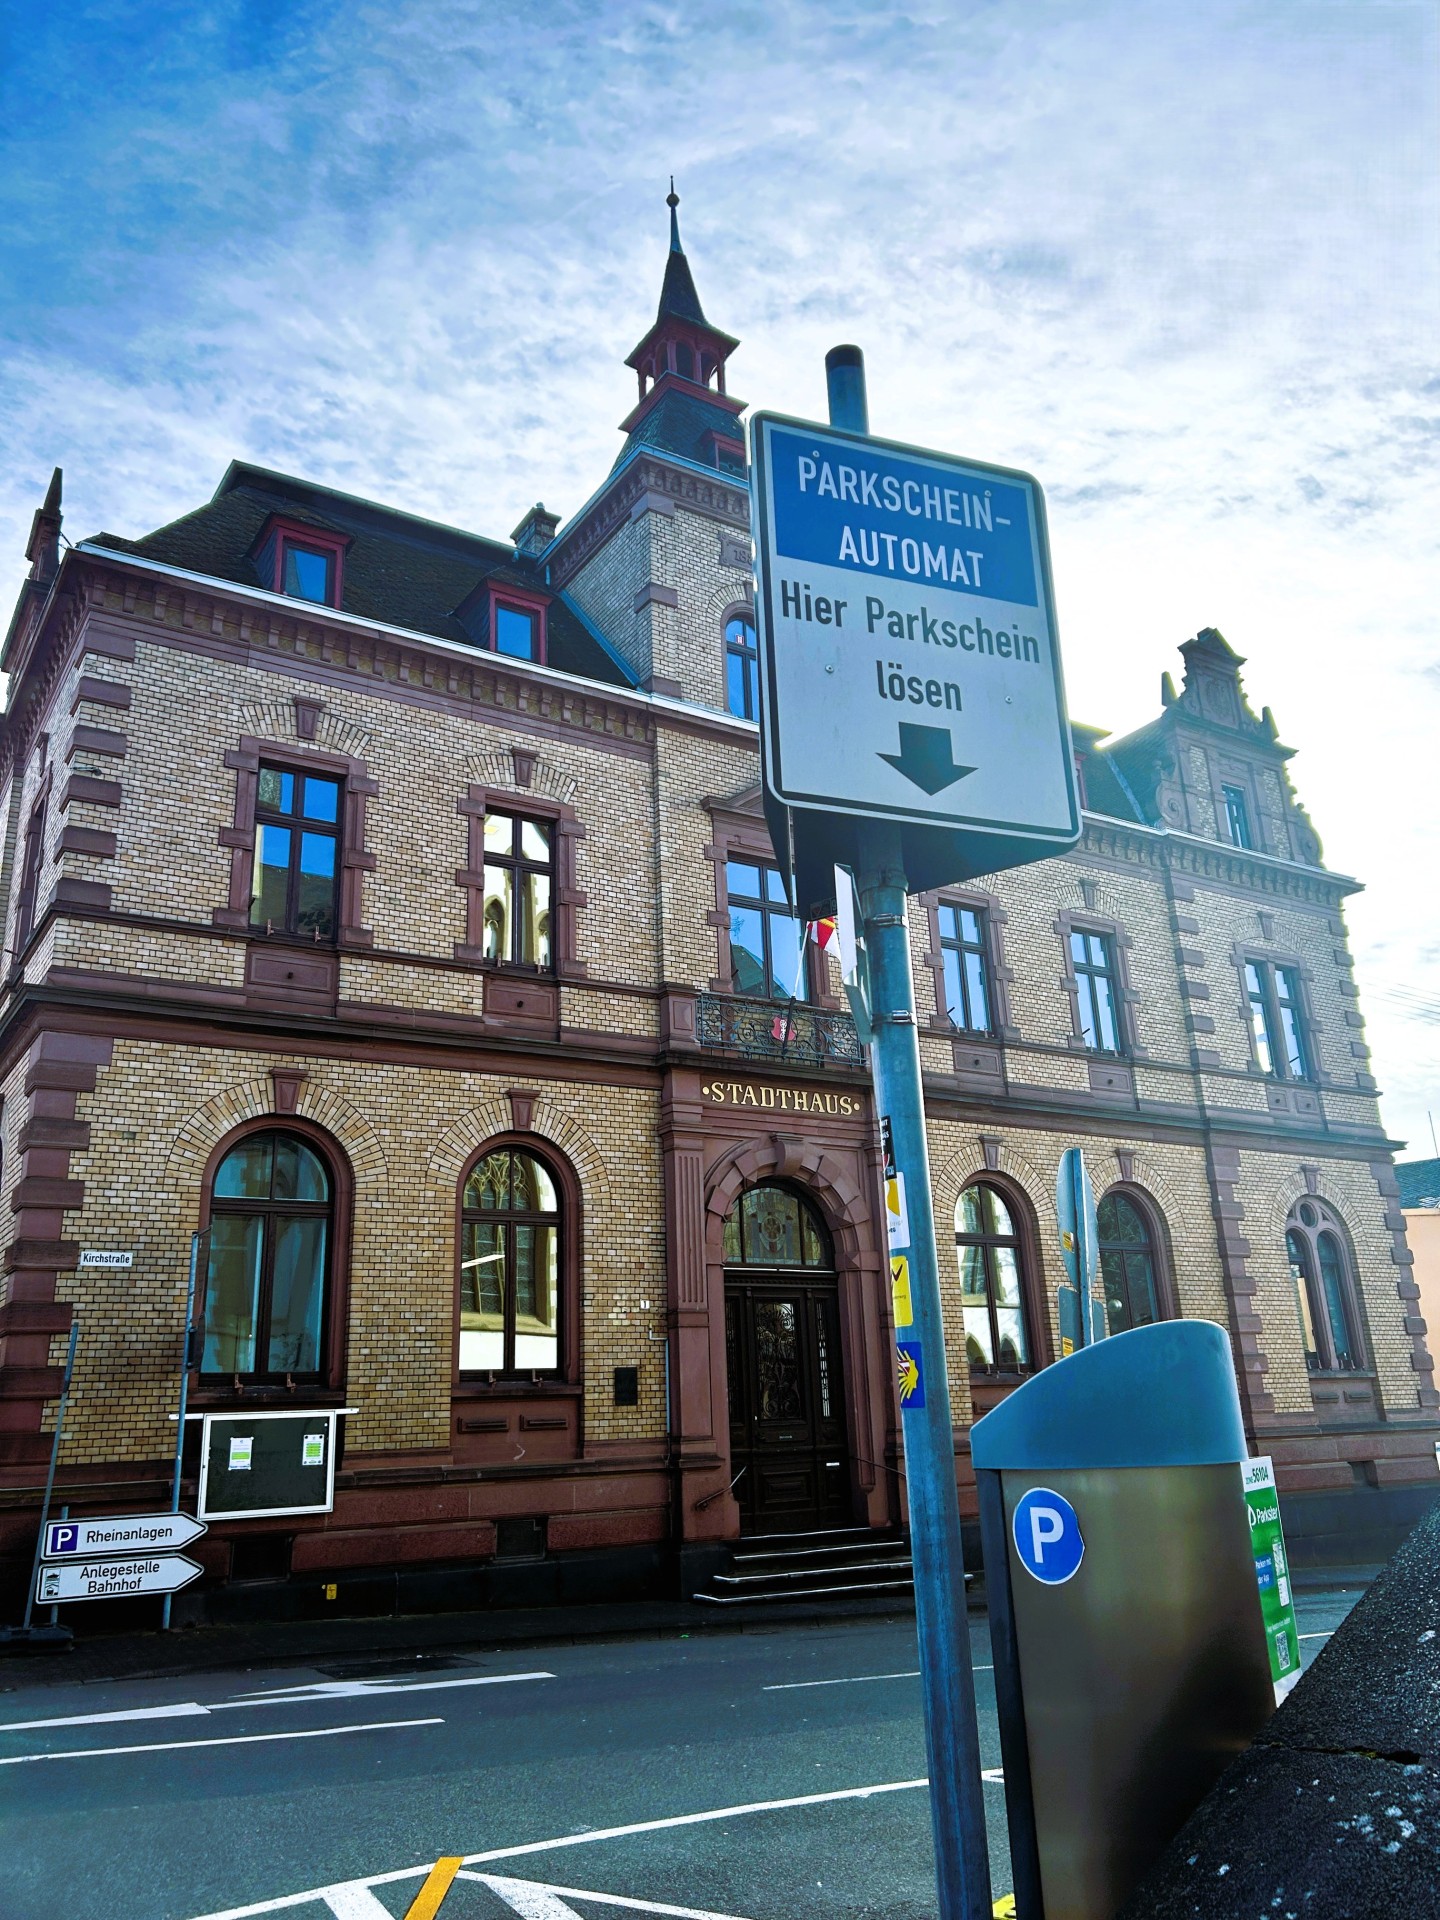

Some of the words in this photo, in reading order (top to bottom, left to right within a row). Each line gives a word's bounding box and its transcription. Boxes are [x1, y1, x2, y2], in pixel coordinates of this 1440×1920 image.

[798, 455, 1011, 532] PARKSCHEIN-
[838, 525, 984, 588] AUTOMAT
[781, 579, 848, 628] Hier
[866, 596, 1041, 664] Parkschein
[876, 660, 963, 712] lösen
[711, 1081, 852, 1116] STADTHAUS
[83, 1252, 130, 1264] Kirchstraße
[1252, 1465, 1269, 1483] 56104
[1256, 1505, 1279, 1524] Parkster
[56, 1528, 73, 1550] P
[86, 1526, 173, 1543] Rheinanlagen
[1029, 1506, 1065, 1564] P
[80, 1561, 160, 1580] Anlegestelle
[87, 1577, 142, 1594] Bahnhof
